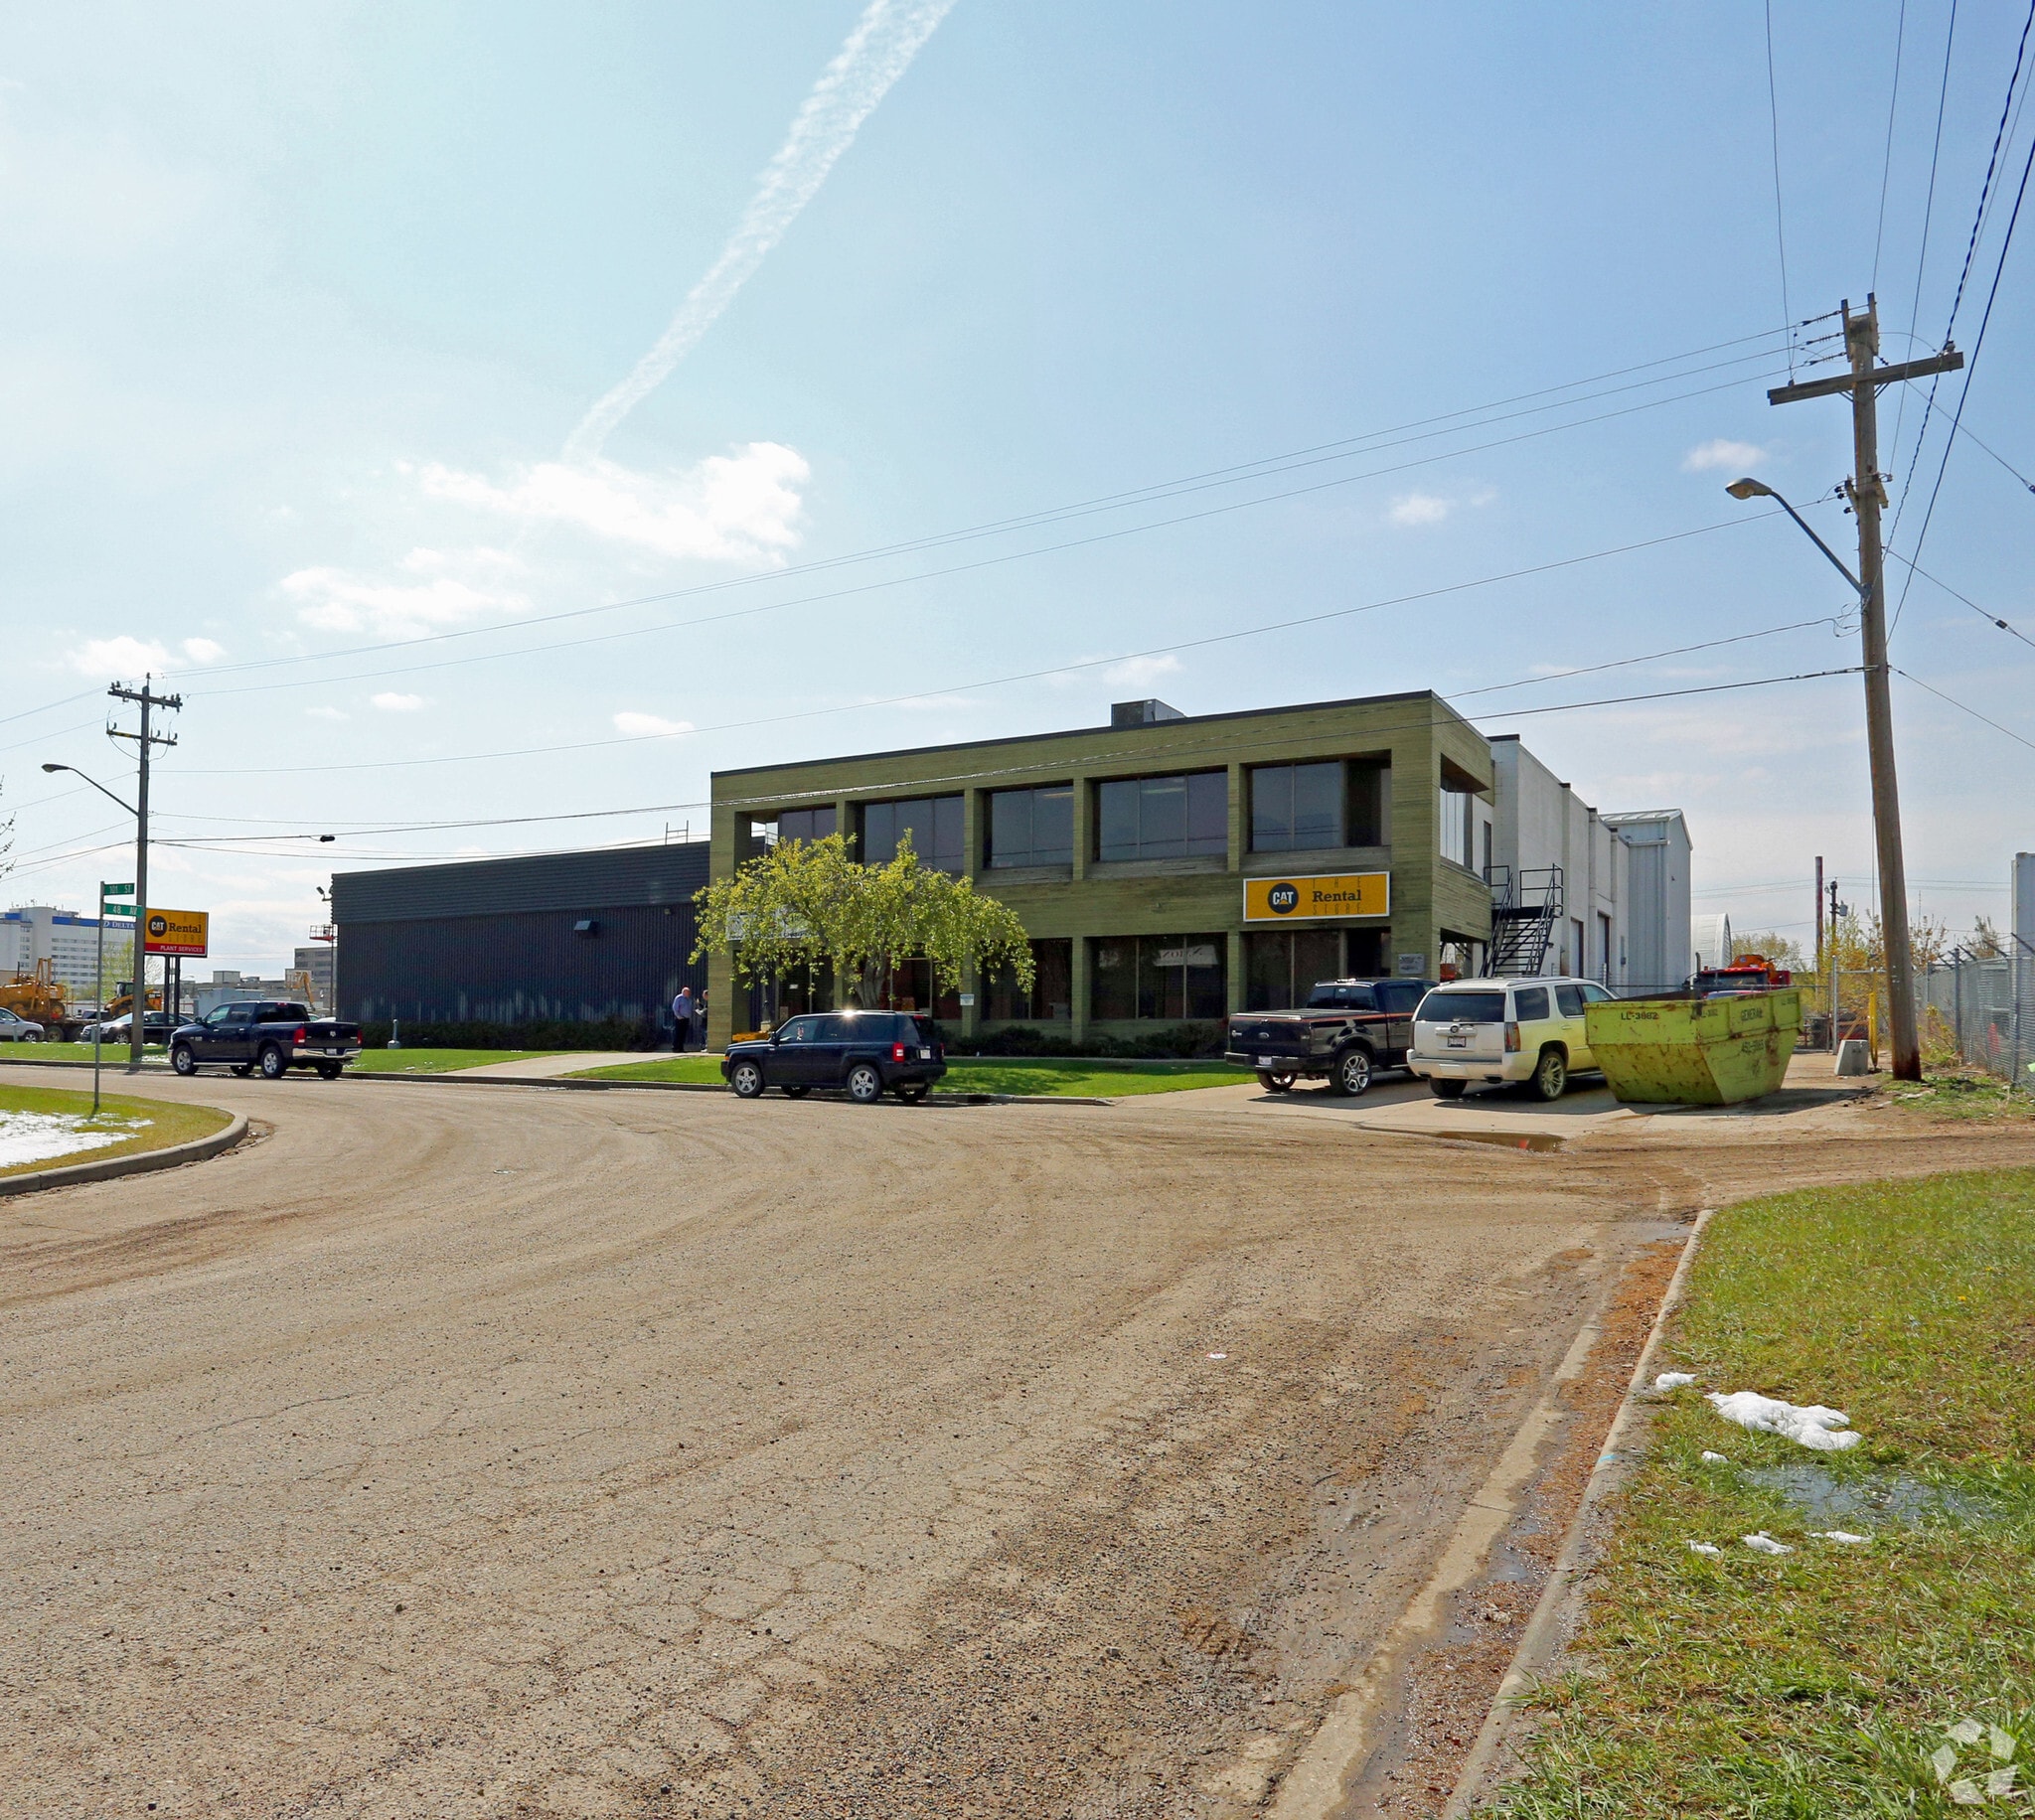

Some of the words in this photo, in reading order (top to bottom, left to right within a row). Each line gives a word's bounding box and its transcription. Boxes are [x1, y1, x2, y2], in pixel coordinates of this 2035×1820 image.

[124, 884, 132, 893] ST
[1272, 891, 1295, 905] CAT
[1312, 889, 1361, 903] Rental
[129, 907, 138, 916] AV
[151, 921, 165, 931] CAT
[168, 922, 201, 934] Rental
